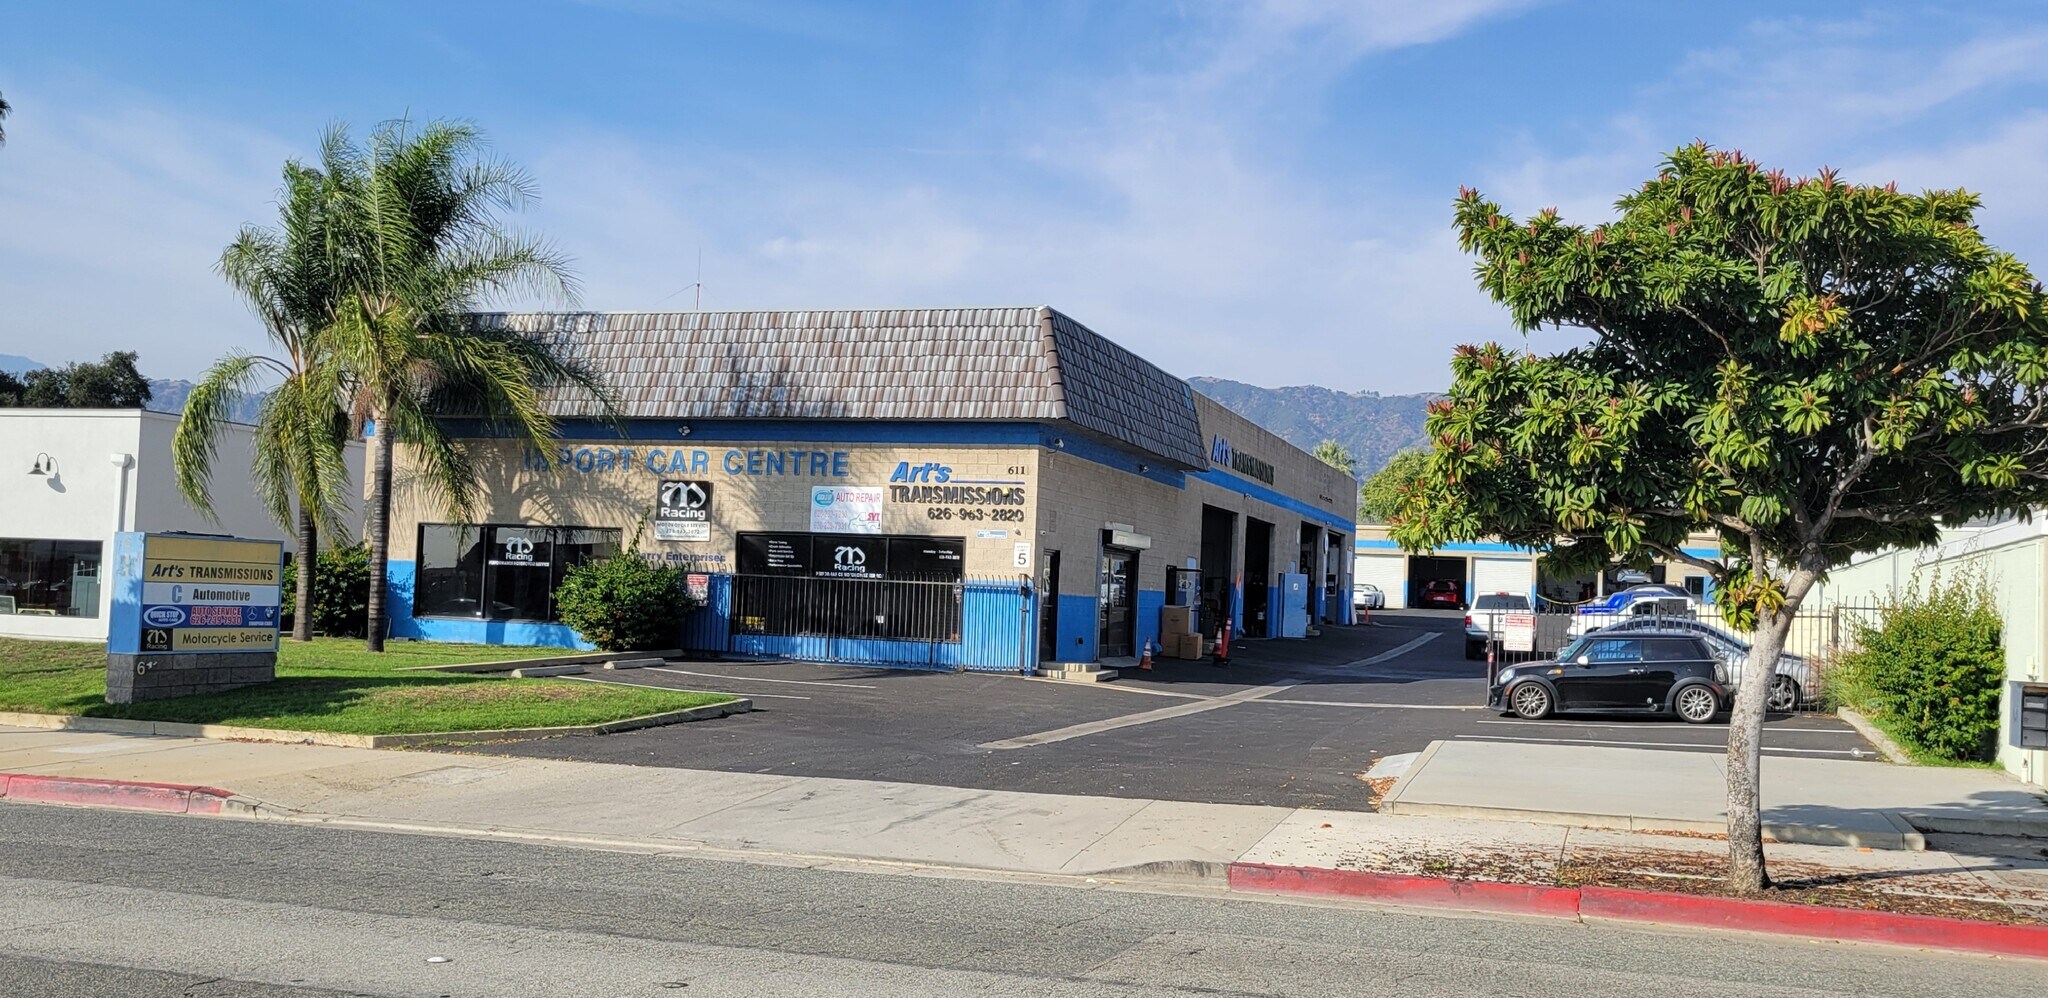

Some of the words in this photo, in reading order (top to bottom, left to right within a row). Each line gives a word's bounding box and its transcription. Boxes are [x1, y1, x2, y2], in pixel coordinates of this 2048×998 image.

[646, 449, 710, 474] CAR
[723, 449, 850, 477] CENTRE
[890, 461, 952, 483] Art's
[1008, 466, 1025, 475] 611
[836, 492, 854, 503] AUTO
[856, 493, 880, 503] REPAIR
[889, 485, 1025, 506] TRANSMISSIONS
[660, 506, 706, 521] Racing
[506, 552, 533, 561] Racing
[1018, 553, 1027, 565] 5
[152, 564, 185, 578] Art's
[190, 566, 274, 581] TRANSMISSIONS
[834, 563, 866, 573] Racing
[172, 585, 182, 603] C
[193, 589, 250, 602] Automotive
[191, 606, 211, 616] AUTO
[212, 606, 242, 616] SERVICE
[182, 632, 236, 645] Motorcycle
[240, 631, 273, 642] Service
